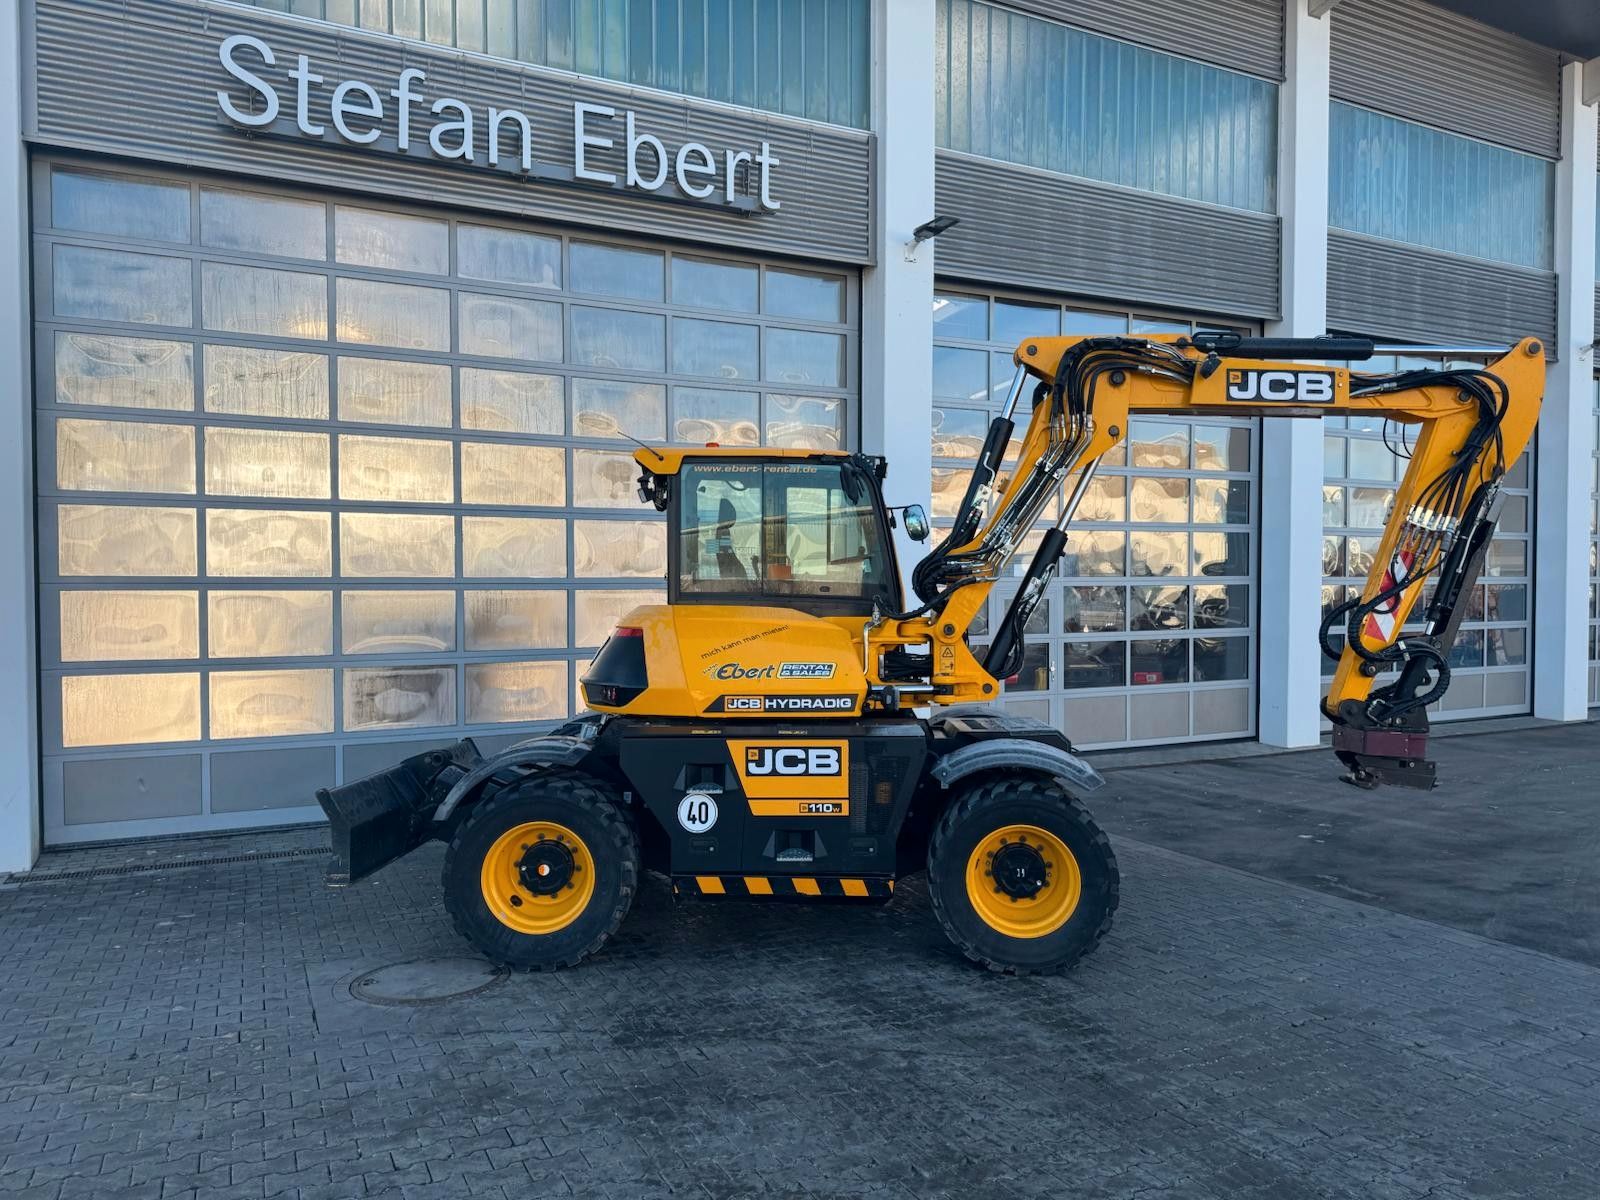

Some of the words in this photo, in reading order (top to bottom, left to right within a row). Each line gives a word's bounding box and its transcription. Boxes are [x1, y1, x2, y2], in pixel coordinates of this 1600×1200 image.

[217, 34, 532, 172] Stefan
[573, 100, 781, 211] Ebert
[1228, 371, 1333, 401] JCB
[701, 647, 721, 659] mich
[721, 640, 742, 651] kann
[743, 633, 760, 644] man
[717, 663, 775, 680] Ebert
[727, 699, 761, 709] JCB
[765, 698, 852, 709] HYDRADIG
[747, 748, 840, 775] JCB
[687, 801, 709, 825] 40
